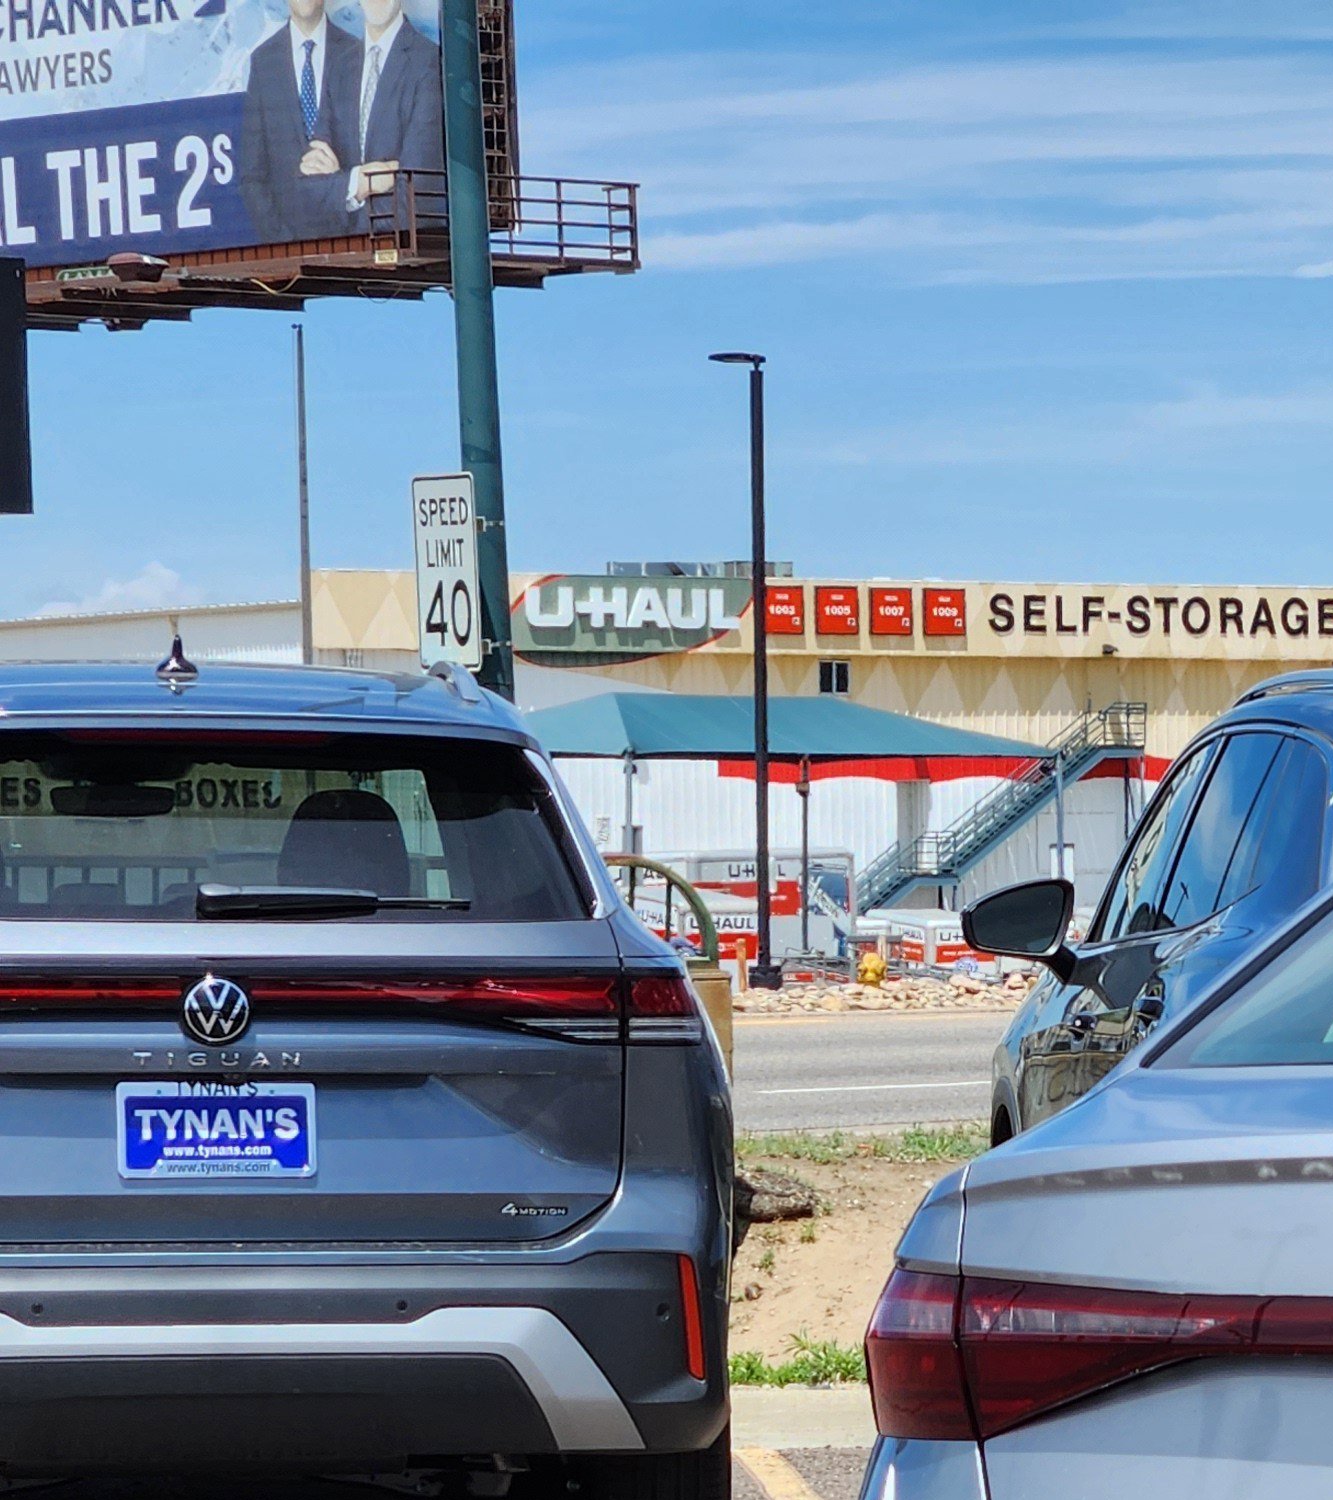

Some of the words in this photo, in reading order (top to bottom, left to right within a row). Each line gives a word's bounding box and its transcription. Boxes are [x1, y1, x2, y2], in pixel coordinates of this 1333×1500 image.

[0, 0, 179, 42] HANKE
[46, 141, 161, 240] THE
[419, 497, 468, 526] SPEED
[426, 538, 464, 567] LIMIT
[426, 579, 471, 646] 40
[878, 605, 905, 616] 1007
[690, 916, 756, 931] UHAUL
[133, 1052, 301, 1067] TIGUAN
[134, 1108, 300, 1141] TYNAN'S
[163, 1145, 272, 1158] www.tynans.com
[166, 1163, 270, 1174] www.tynans.com
[501, 1202, 567, 1217] 4MOTION
